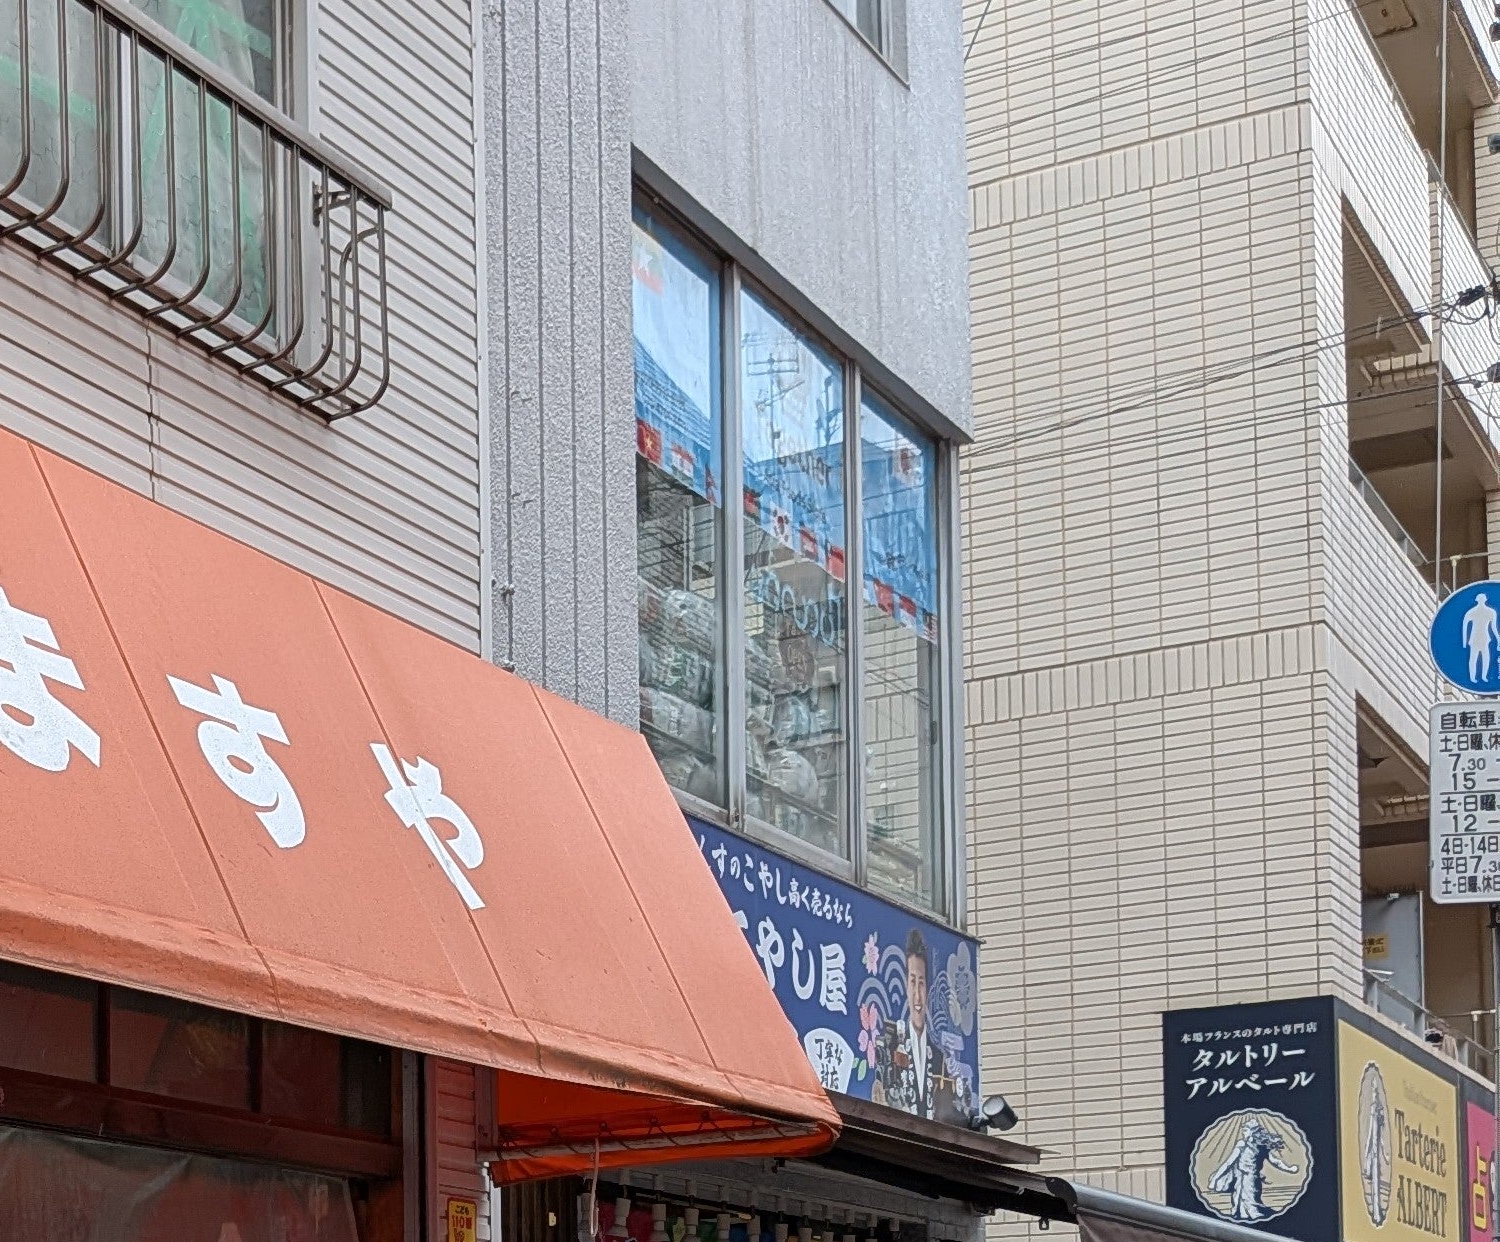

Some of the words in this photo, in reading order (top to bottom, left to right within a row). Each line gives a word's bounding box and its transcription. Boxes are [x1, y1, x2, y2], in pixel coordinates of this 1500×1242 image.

[1440, 711, 1500, 730] 自転車
[1191, 1042, 1306, 1072] タルトリー
[1185, 1071, 1316, 1100] アルベール
[1394, 1107, 1447, 1178] Tarterie
[1396, 1174, 1448, 1239] ALBERT
